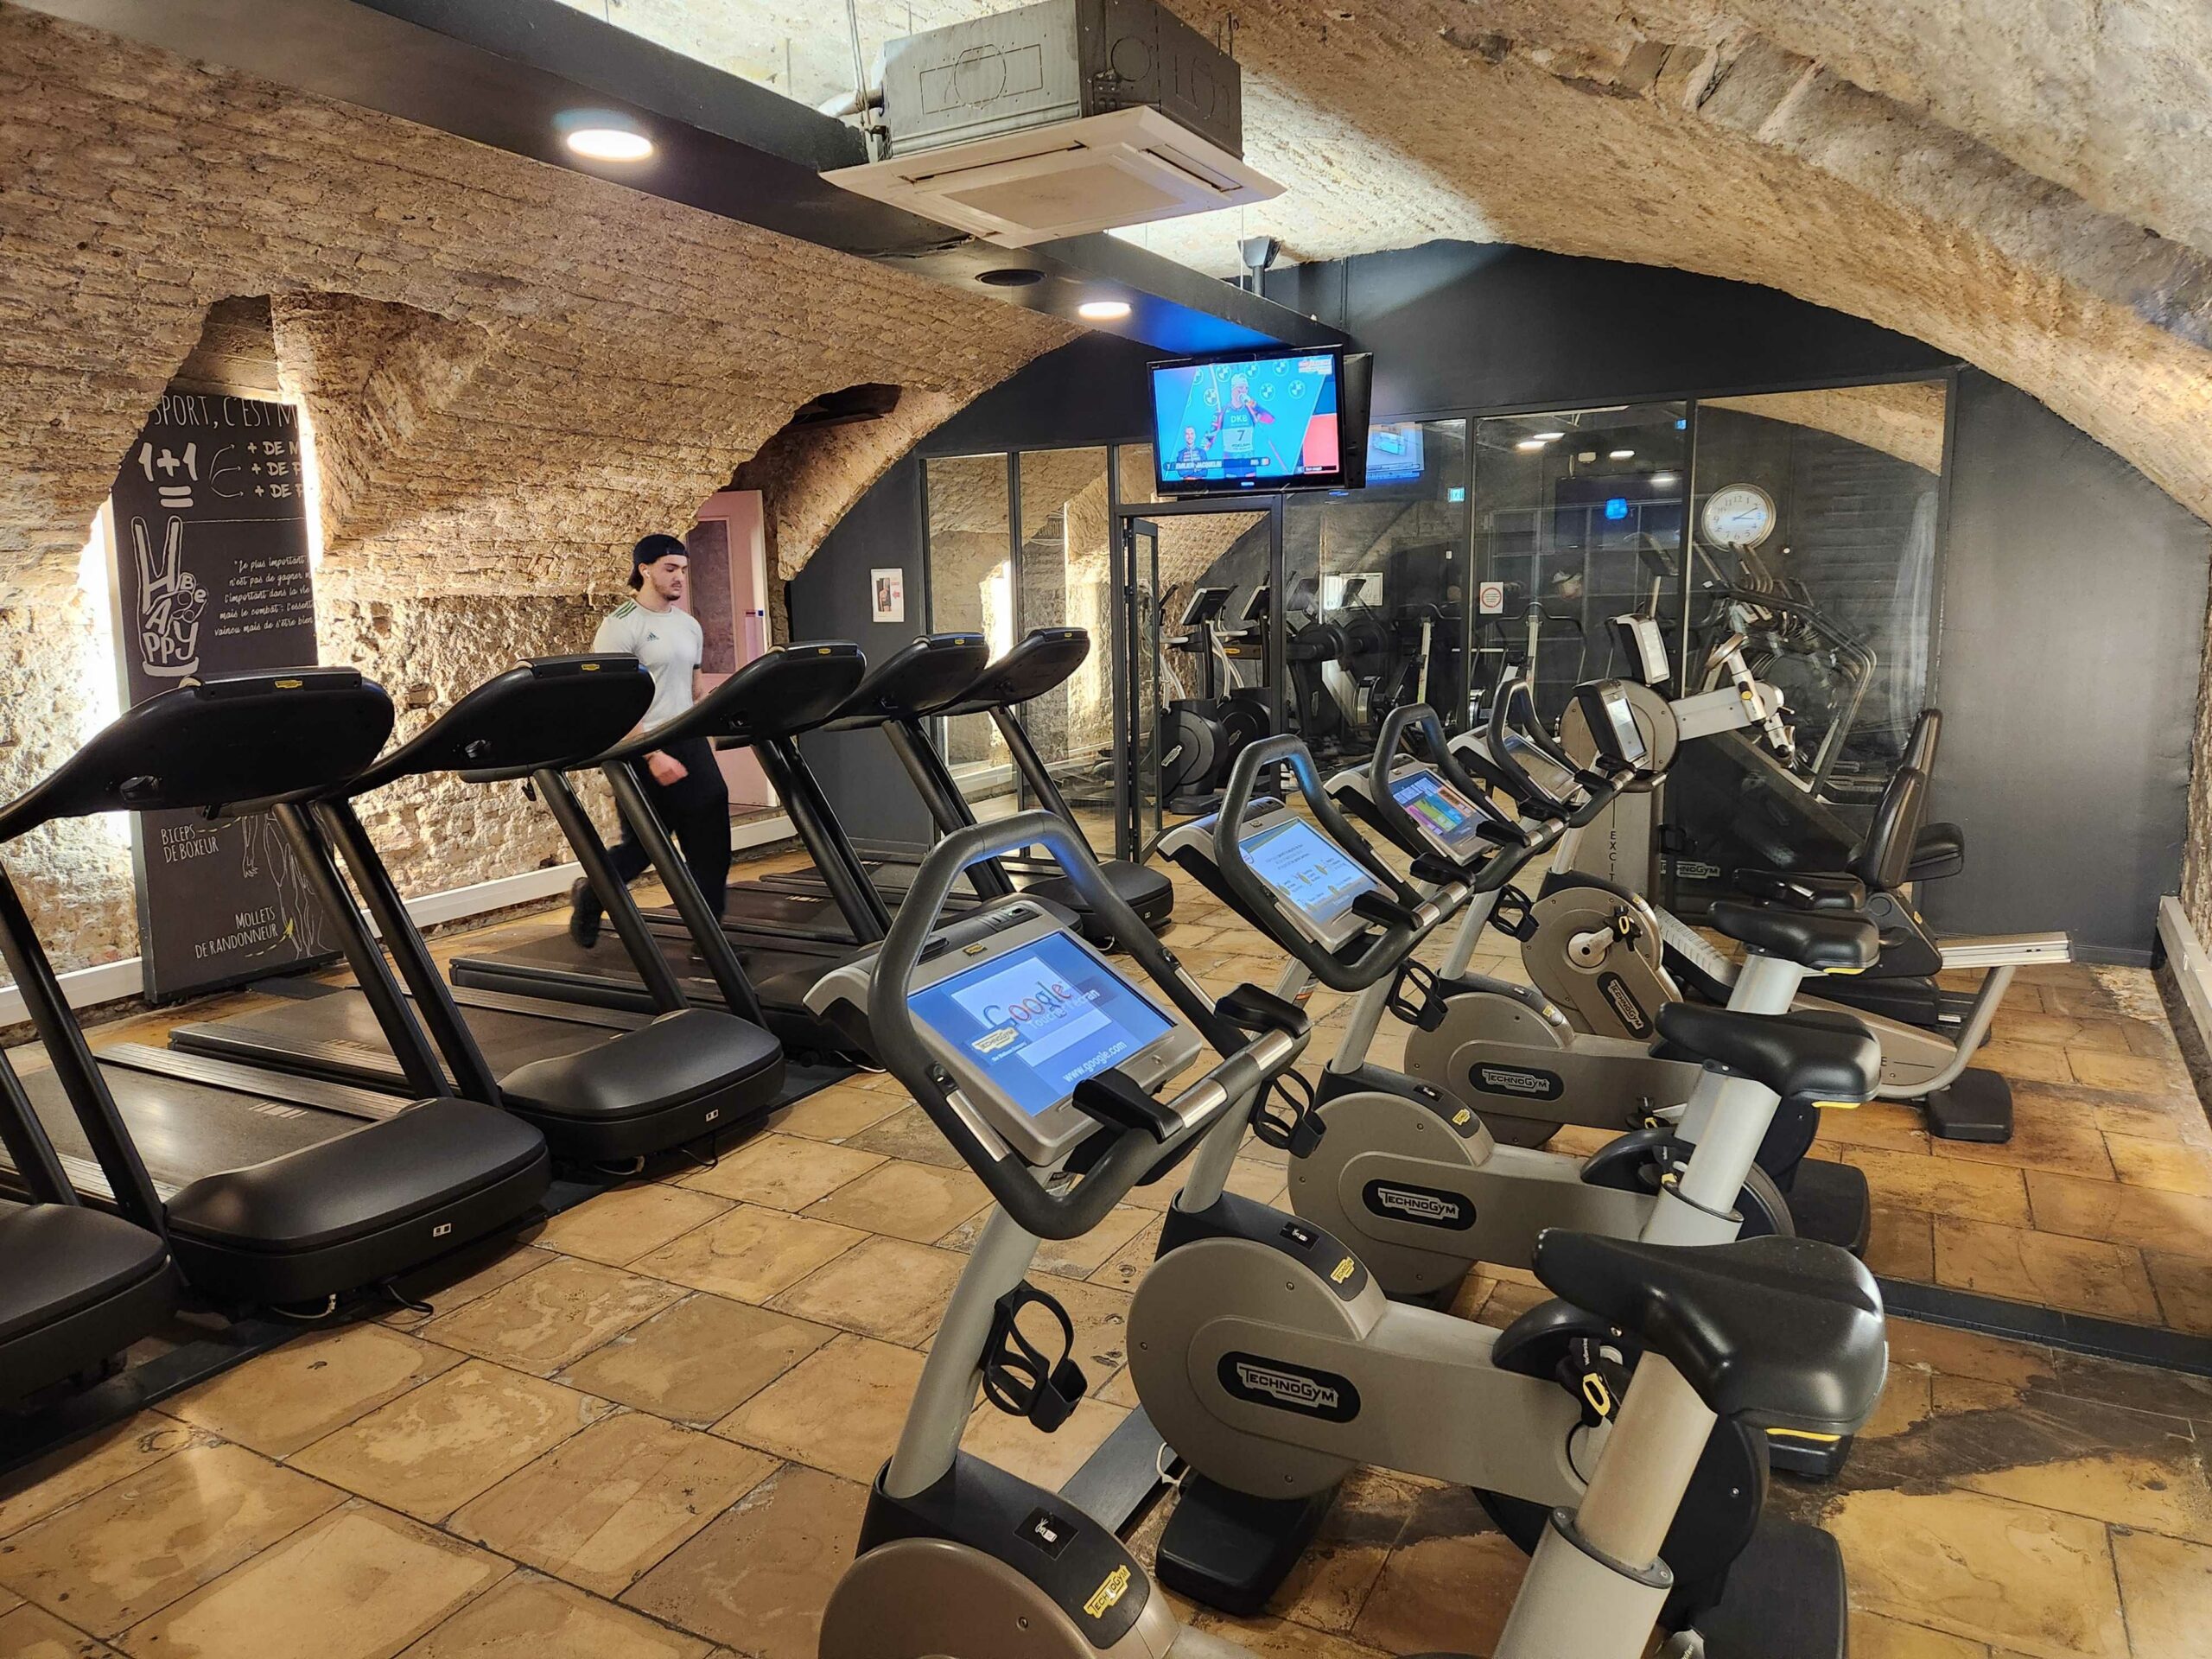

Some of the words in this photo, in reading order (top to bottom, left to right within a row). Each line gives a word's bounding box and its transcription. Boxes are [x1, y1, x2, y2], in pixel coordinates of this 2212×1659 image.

[1237, 429, 1245, 441] 7
[263, 441, 285, 455] DE
[267, 461, 289, 476] DE
[270, 484, 293, 498] DE
[250, 577, 263, 588] pas
[265, 573, 275, 582] de
[277, 572, 302, 586] gagner
[270, 588, 287, 598] dans
[219, 609, 238, 620] mais
[251, 604, 281, 615] combat
[214, 626, 241, 636] vaincu
[243, 622, 261, 632] mais
[264, 620, 274, 630] de
[160, 823, 196, 845] BICEPS
[163, 845, 177, 863] DE
[179, 836, 219, 859] BOXEUR
[235, 906, 276, 930] MOLLETS
[194, 944, 208, 959] DE
[209, 924, 278, 954] RANDONNEUR
[1610, 981, 1642, 1027] TECHNOGYM
[1063, 1041, 1127, 1082] www.google.com
[1483, 1071, 1549, 1090] TECHNOGYM
[1379, 1190, 1458, 1216] TECHNOGYM
[1238, 1365, 1336, 1403] TECHNOGYM
